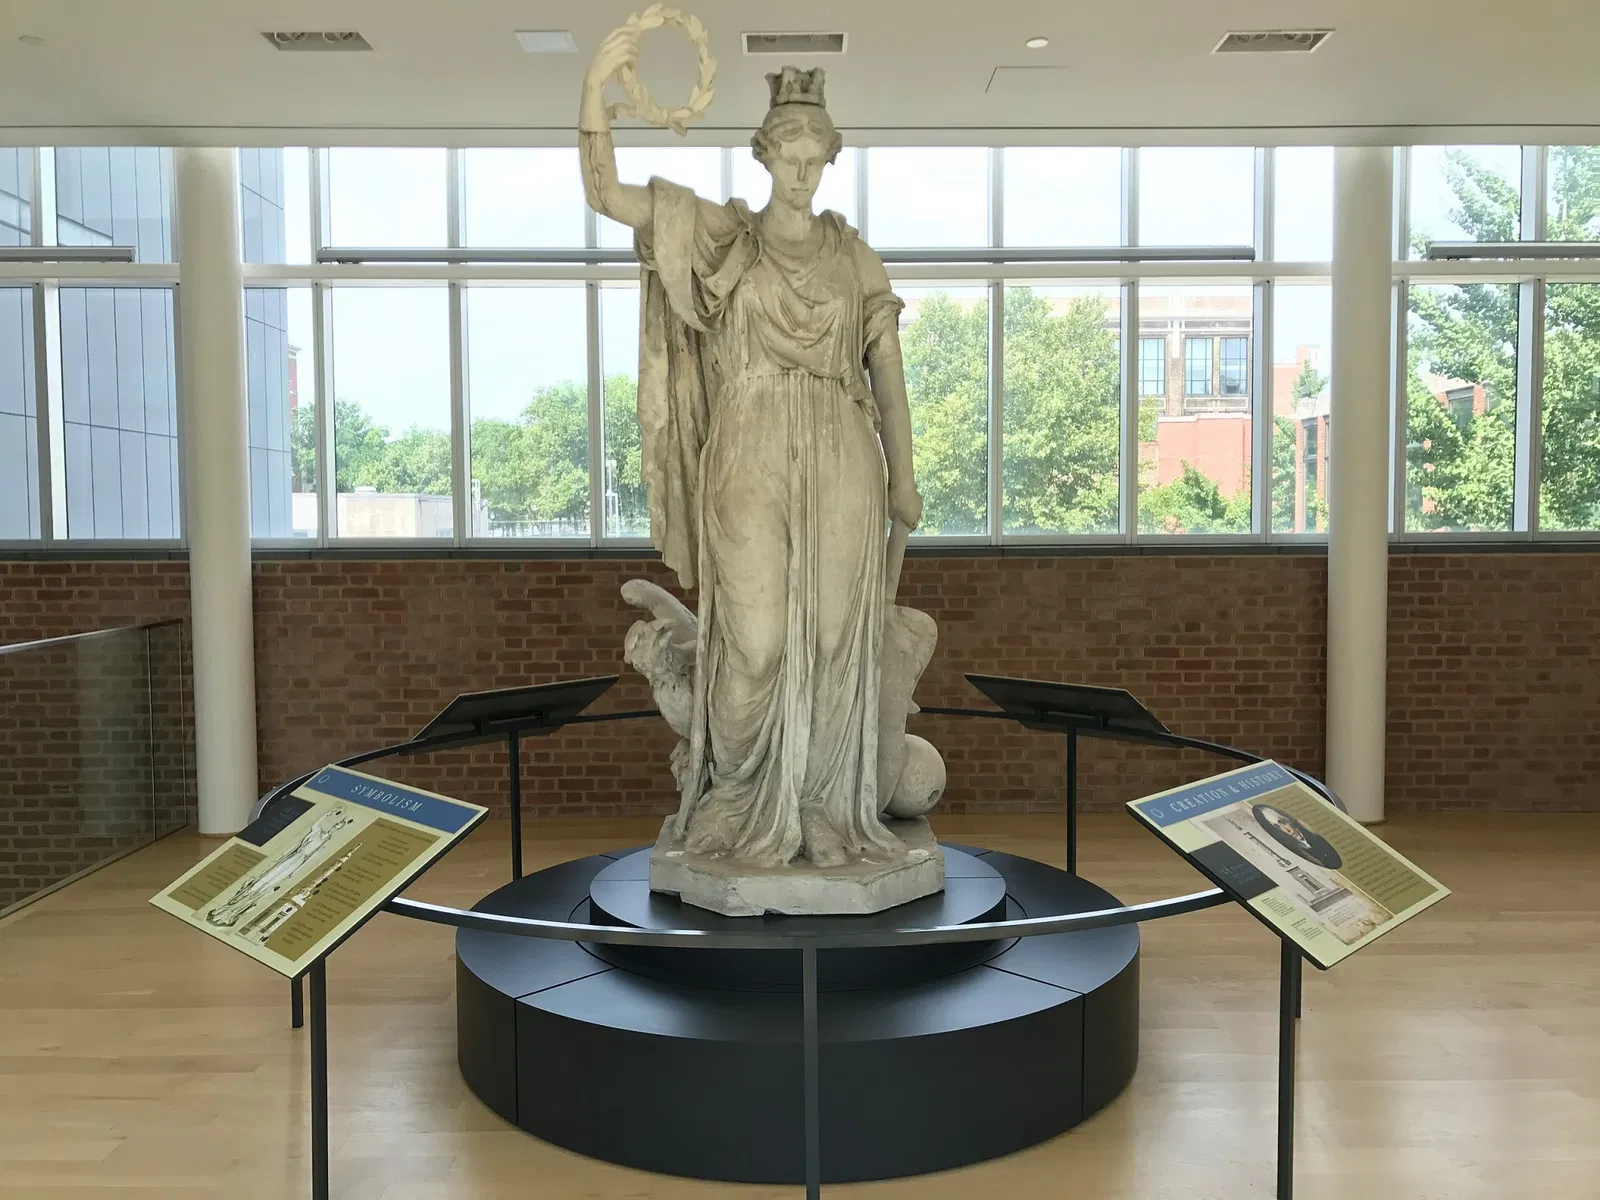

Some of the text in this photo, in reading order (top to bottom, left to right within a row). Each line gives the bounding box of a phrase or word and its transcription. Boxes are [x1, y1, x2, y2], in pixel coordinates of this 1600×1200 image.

[350, 784, 424, 812] SYMBOLISM
[1169, 769, 1283, 813] CREATION & HISTORY
